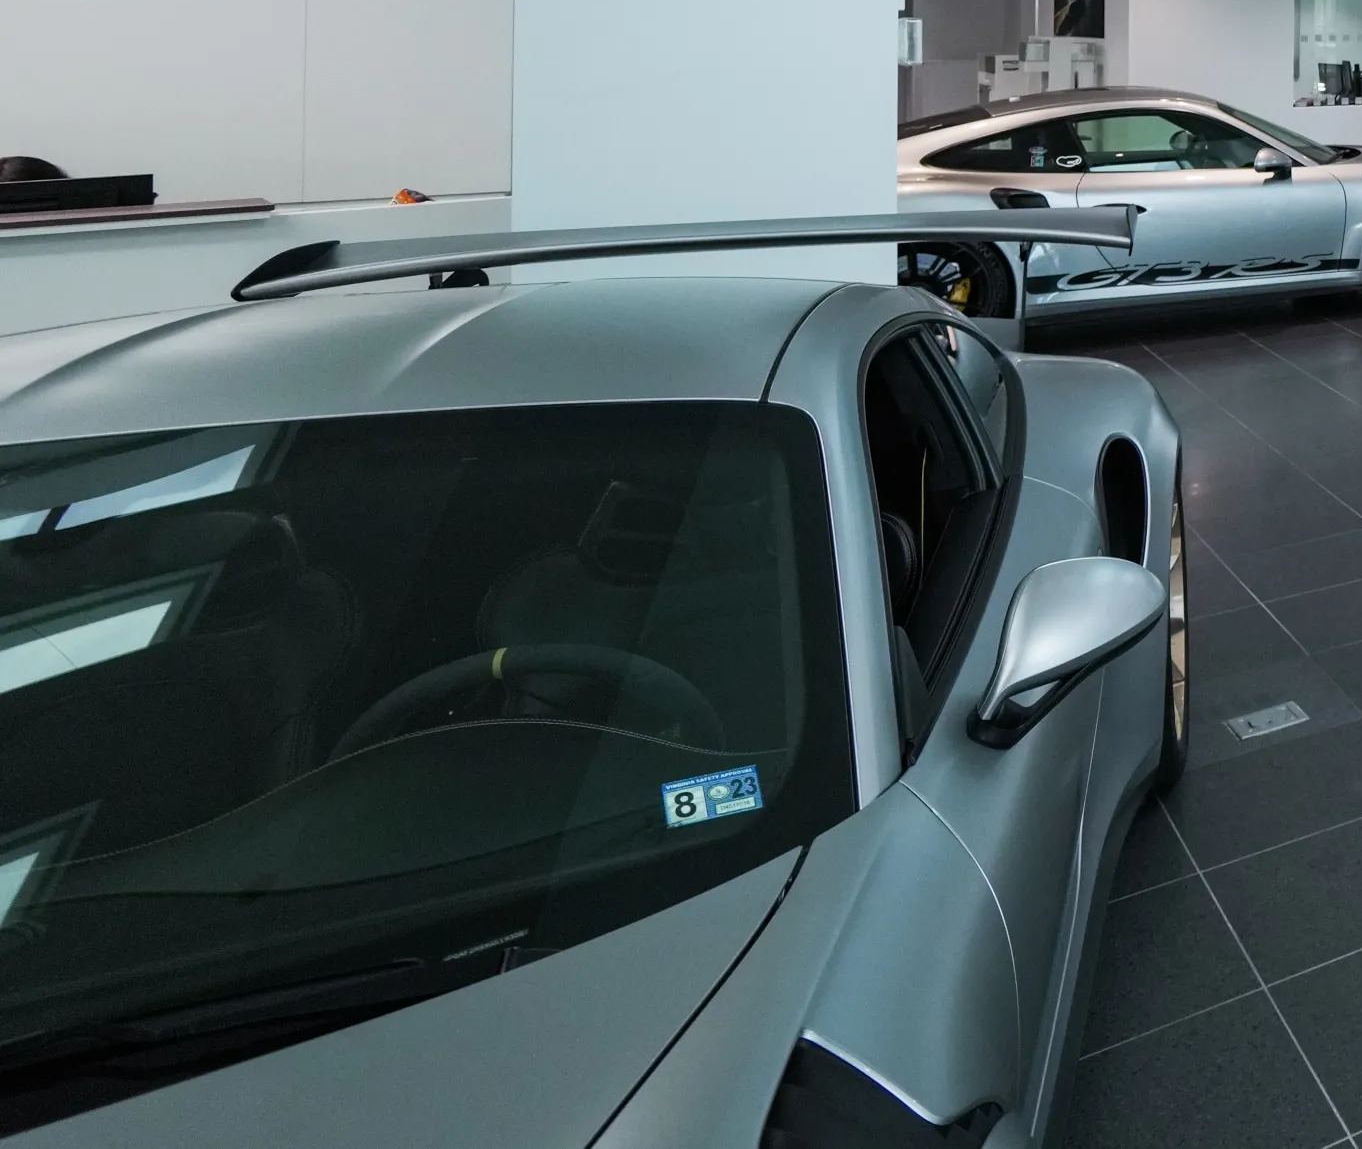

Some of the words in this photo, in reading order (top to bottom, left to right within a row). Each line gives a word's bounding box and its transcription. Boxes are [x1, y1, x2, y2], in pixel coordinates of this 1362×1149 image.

[1056, 260, 1210, 291] GT3
[665, 780, 696, 790] VIRGINIA
[696, 774, 720, 784] SAFETY
[720, 768, 752, 779] APPROVAL
[730, 776, 758, 798] 23
[674, 791, 697, 818] 8
